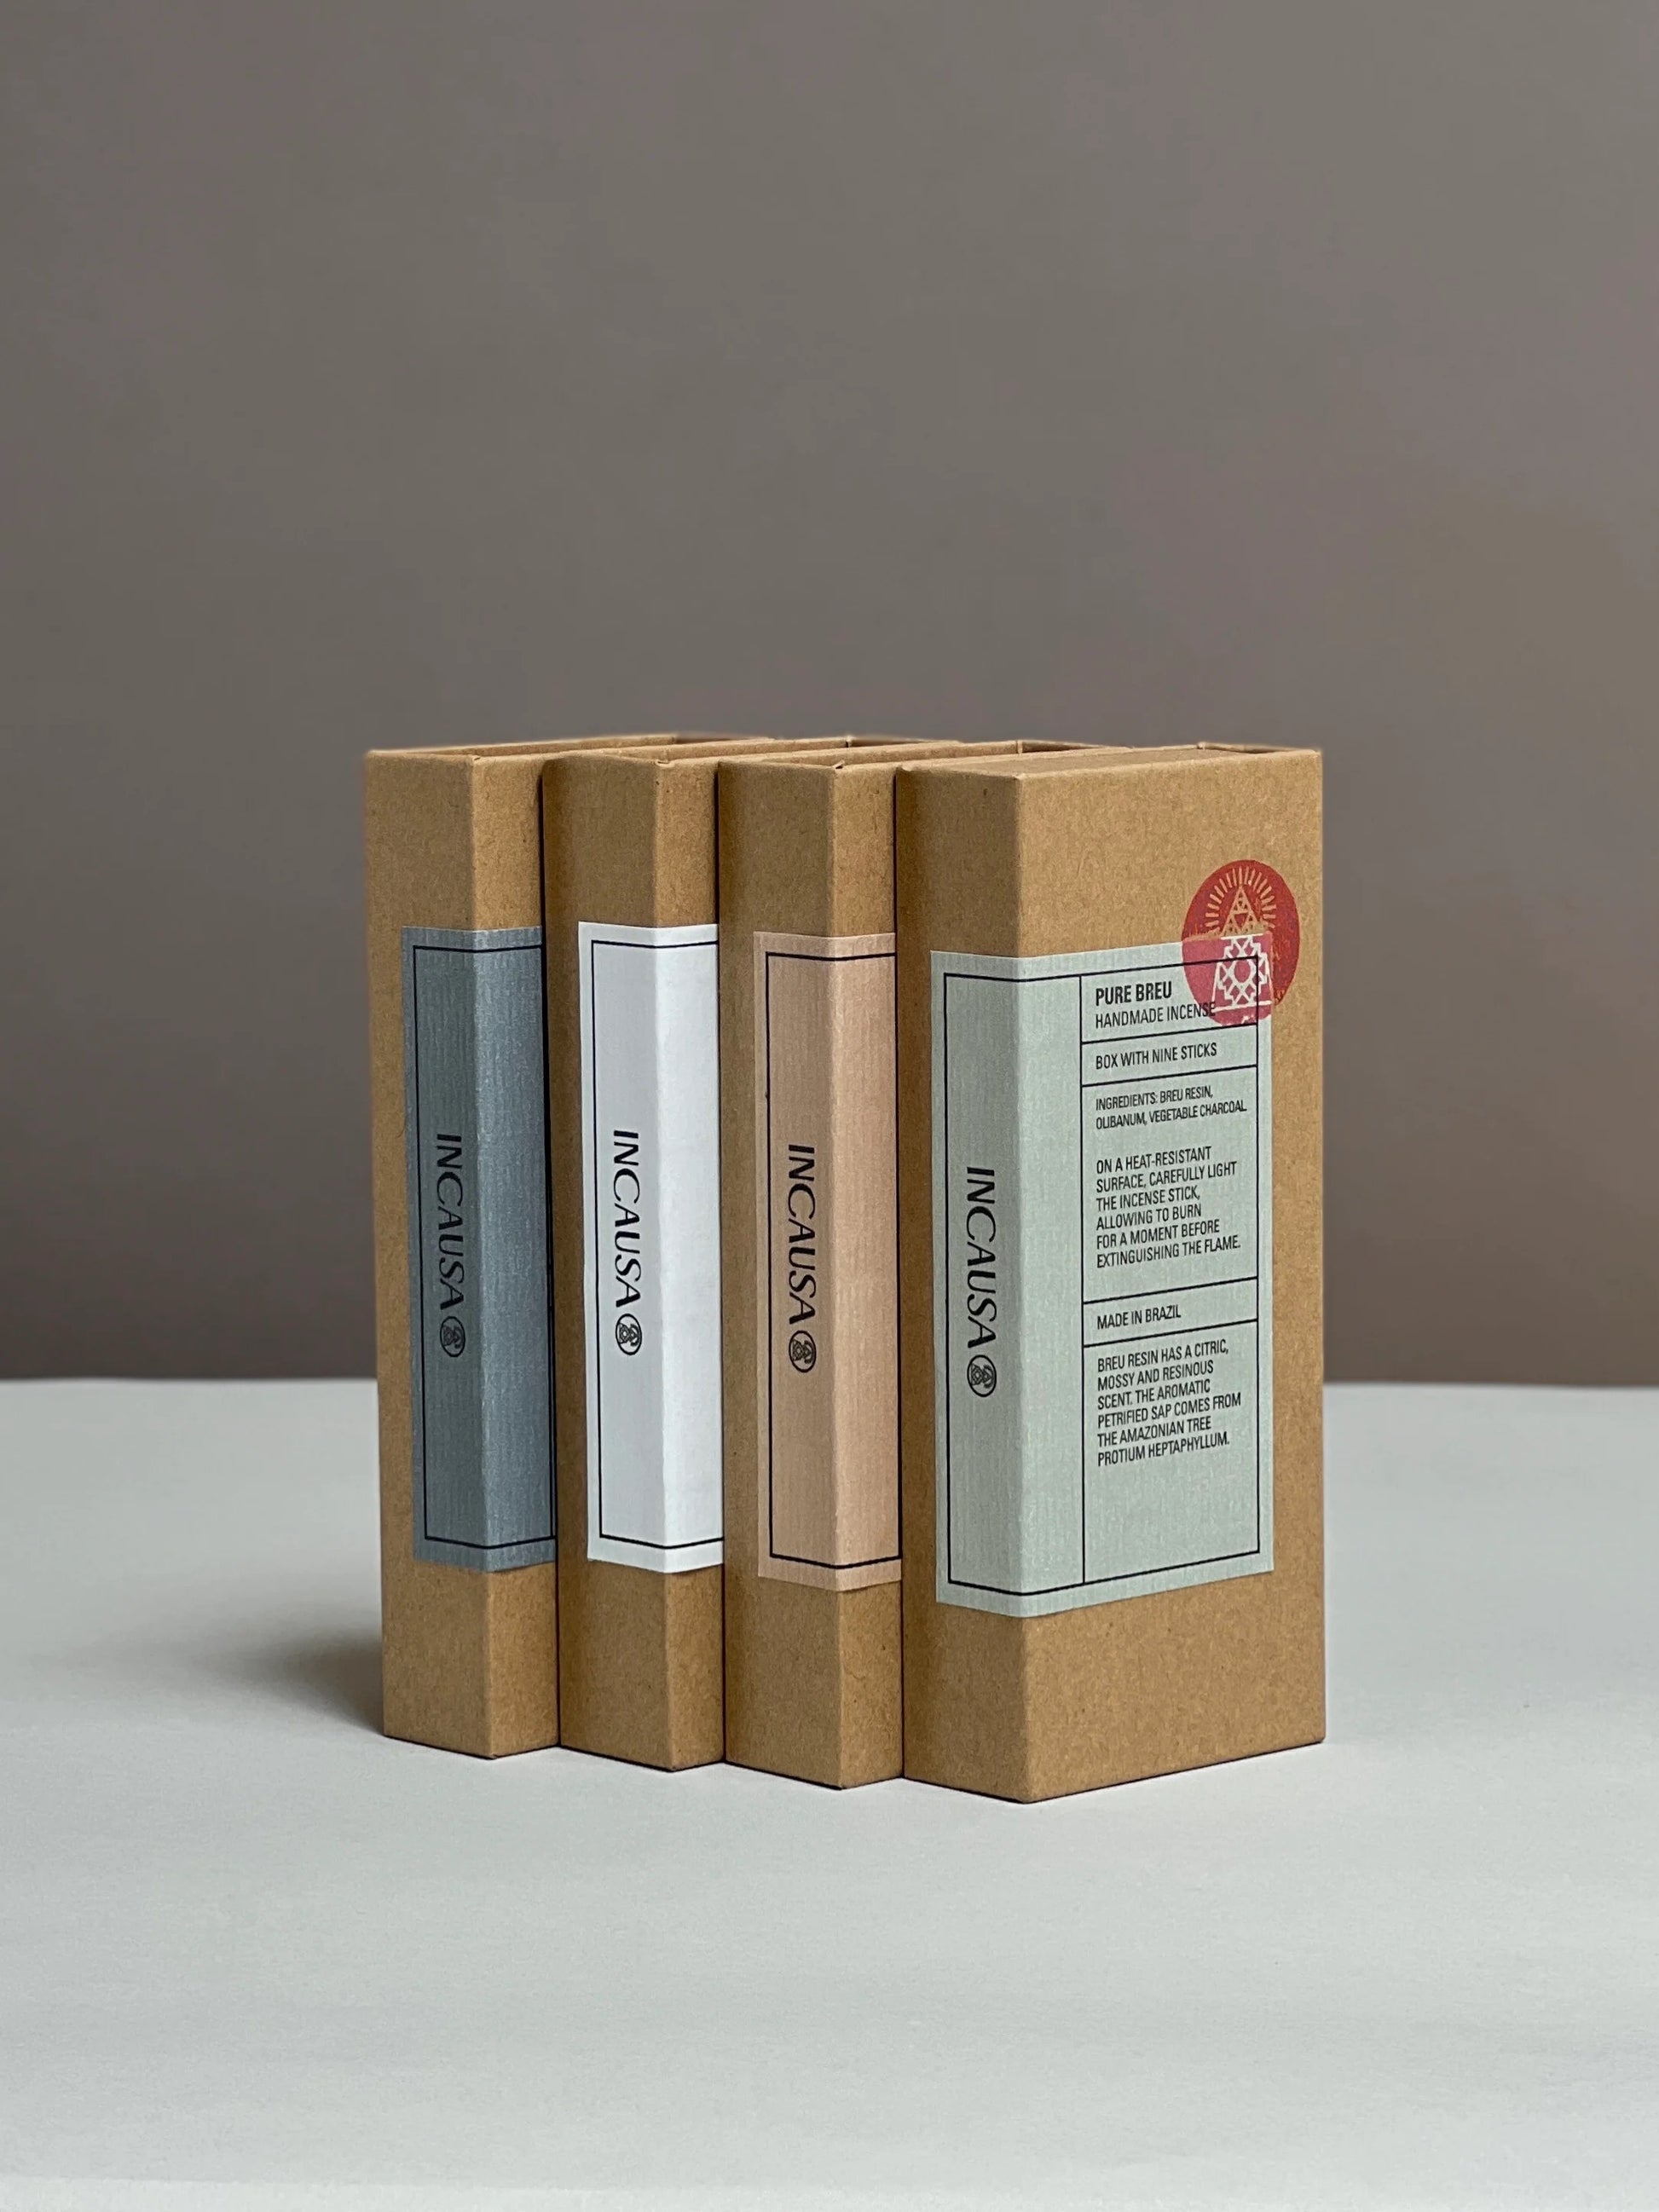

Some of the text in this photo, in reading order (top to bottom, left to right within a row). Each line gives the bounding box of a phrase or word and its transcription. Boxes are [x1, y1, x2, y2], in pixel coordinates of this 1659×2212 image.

[1095, 981, 1172, 1006] PURE BREU
[1095, 1002, 1216, 1029] HANDMADE INCENSE
[1096, 1042, 1217, 1069] BOX WITH NINE STICKS
[1096, 1085, 1213, 1111] INGREDIENTS: BREU RESIN,
[1096, 1112, 1147, 1129] OLIBANUM,
[1149, 1106, 1198, 1123] VEGETABLE
[1096, 1146, 1211, 1174] ON A HEAT-RESISTANT
[1096, 1161, 1237, 1193] SURFACE, CAREFULLY LIGHT
[1096, 1185, 1199, 1210] THE INCENSE STICK,
[436, 1134, 465, 1310] INCAUSA
[613, 1130, 641, 1308] INCAUSA
[1096, 1204, 1201, 1230] ALLOWING TO BURN
[788, 1144, 816, 1325] INCAUSA
[1097, 1219, 1220, 1250] FOR A MOMENT BEFORE
[966, 1166, 997, 1349] INCAUSA
[1097, 1235, 1240, 1268] EXTINGUISHING THE FLAME.
[1097, 1305, 1181, 1330] MADE IN BRAZIL
[1098, 1339, 1228, 1372] BREU RESIN HAS A CITRIC,
[1098, 1360, 1213, 1391] MOSSY AND RESINOUS
[1098, 1379, 1211, 1410] SCENT. THE AROMATIC
[1098, 1392, 1241, 1429] PETRIFIED SAP COMES FROM
[1098, 1416, 1211, 1447] THE AMAZONIAN TREE
[1098, 1431, 1229, 1466] PROTIUM HEPTAPHYLLUM.
